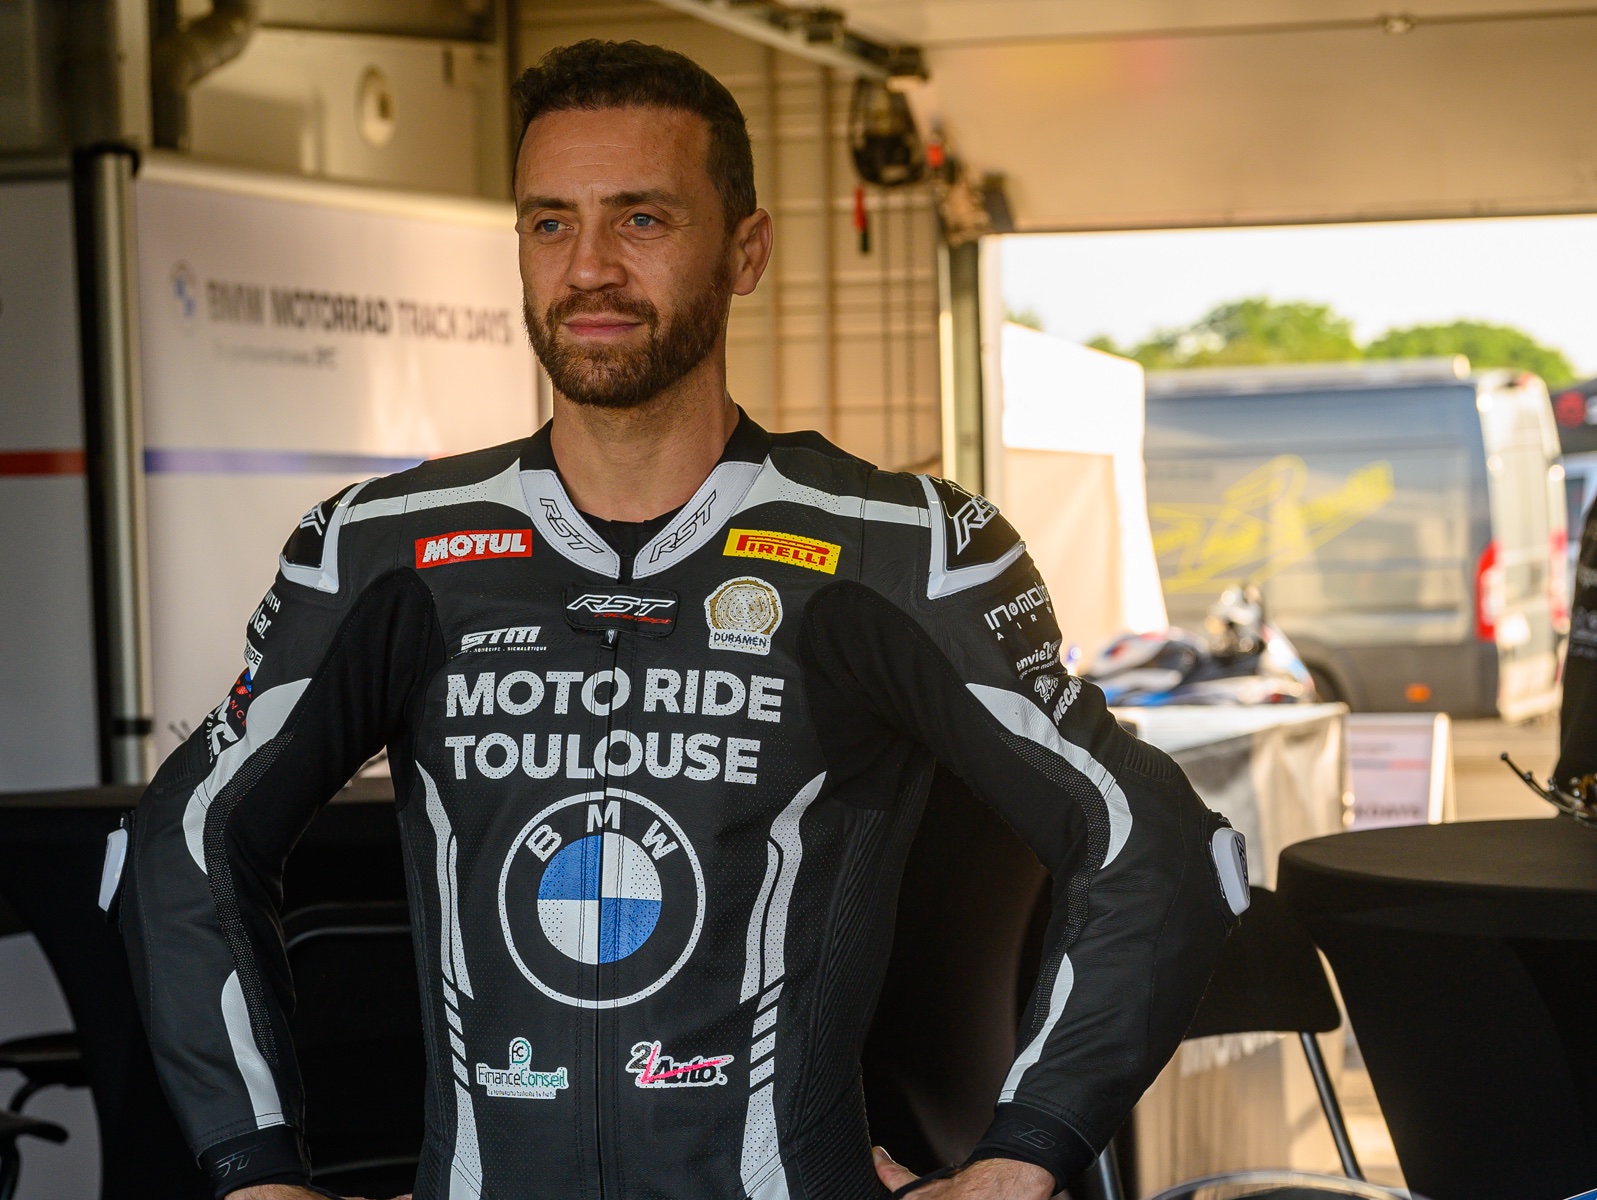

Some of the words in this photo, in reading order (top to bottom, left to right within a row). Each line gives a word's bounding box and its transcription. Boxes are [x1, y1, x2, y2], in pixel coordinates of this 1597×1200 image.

[540, 497, 604, 554] RST
[649, 490, 717, 563] RST
[422, 532, 527, 564] MOTUL
[736, 534, 829, 567] PIRELLI
[566, 593, 676, 617] RST
[461, 626, 541, 650] STM
[713, 632, 768, 648] DURAMEN
[446, 667, 631, 718] MOTO
[643, 668, 785, 723] RIDE
[444, 729, 761, 785] TOULOUSE
[525, 800, 679, 863] BMW
